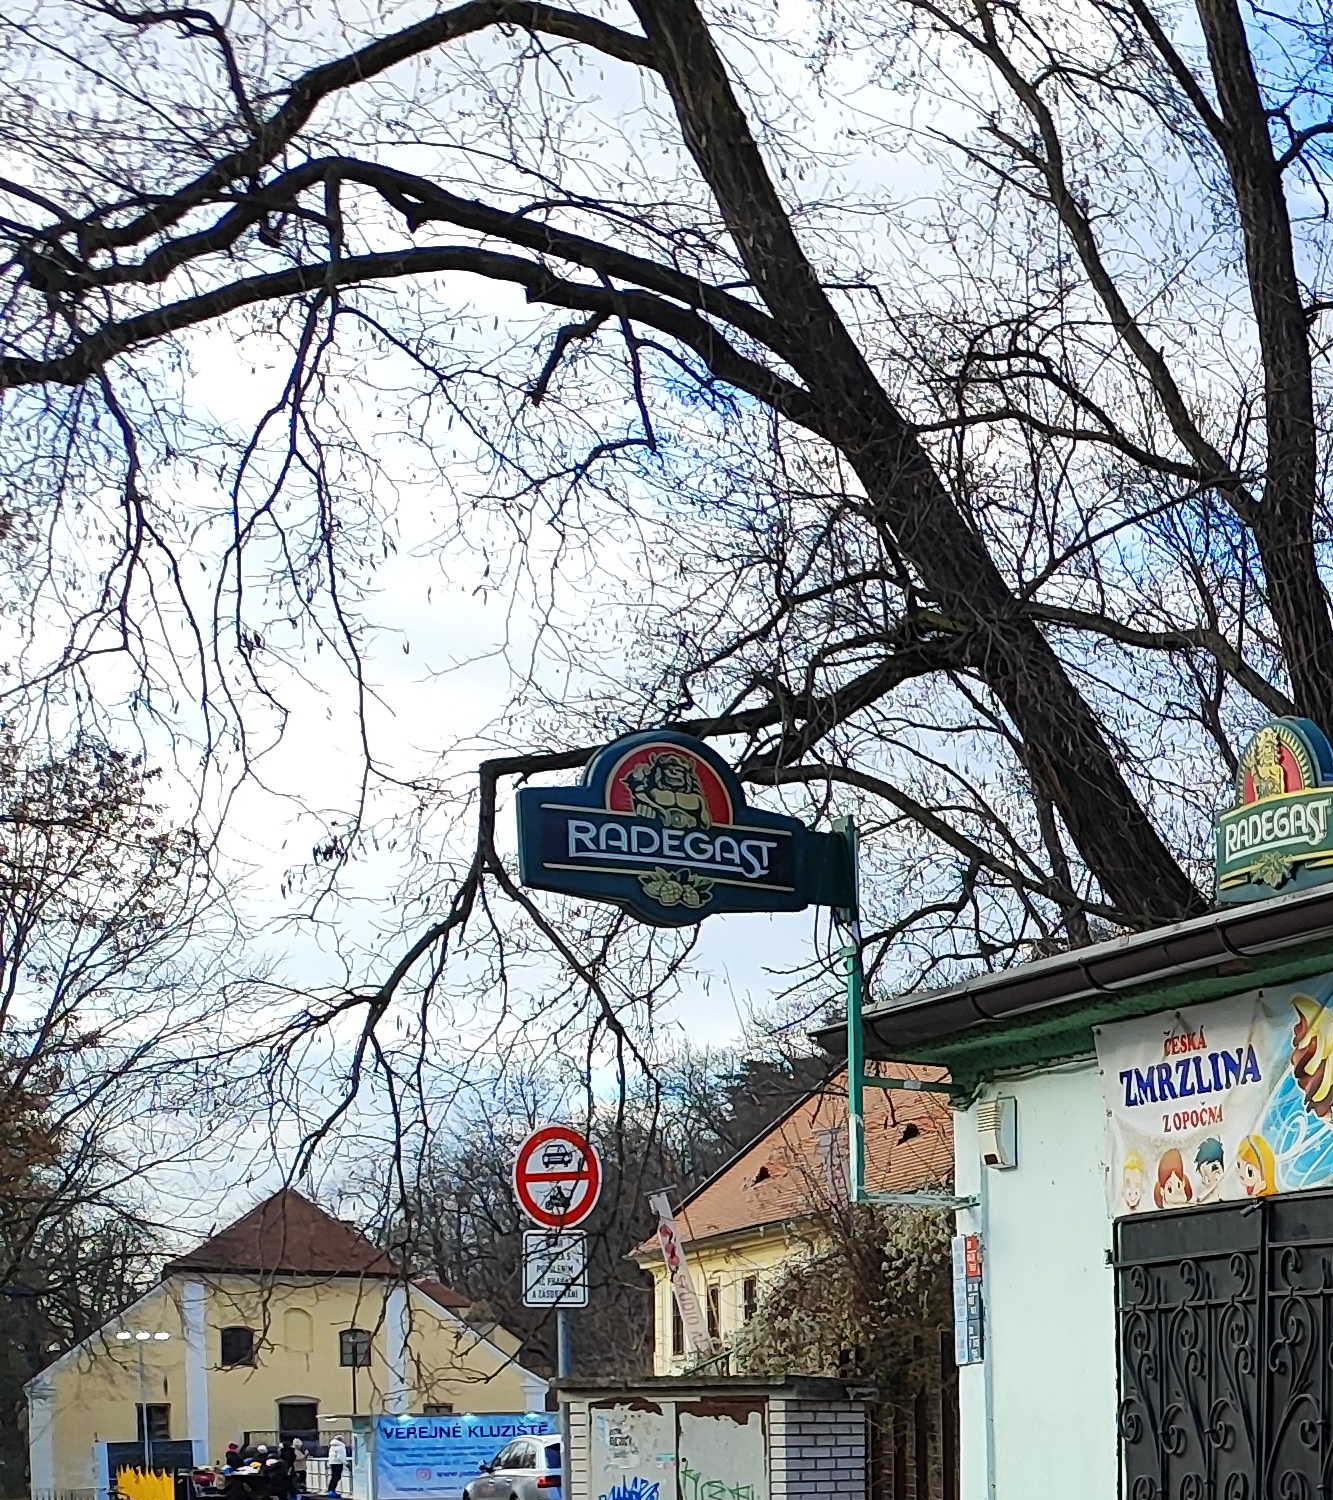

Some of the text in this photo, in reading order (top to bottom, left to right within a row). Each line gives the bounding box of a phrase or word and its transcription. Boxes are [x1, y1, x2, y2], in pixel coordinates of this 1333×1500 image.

[567, 818, 778, 878] RADEGAST
[1225, 798, 1329, 863] RADEGAST
[1163, 1025, 1207, 1057] ČESKÁ
[1120, 1043, 1262, 1107] ZMRZLINA
[1162, 1100, 1224, 1133] Z OPOČNA
[384, 1422, 462, 1440] VEŘEJNÉ
